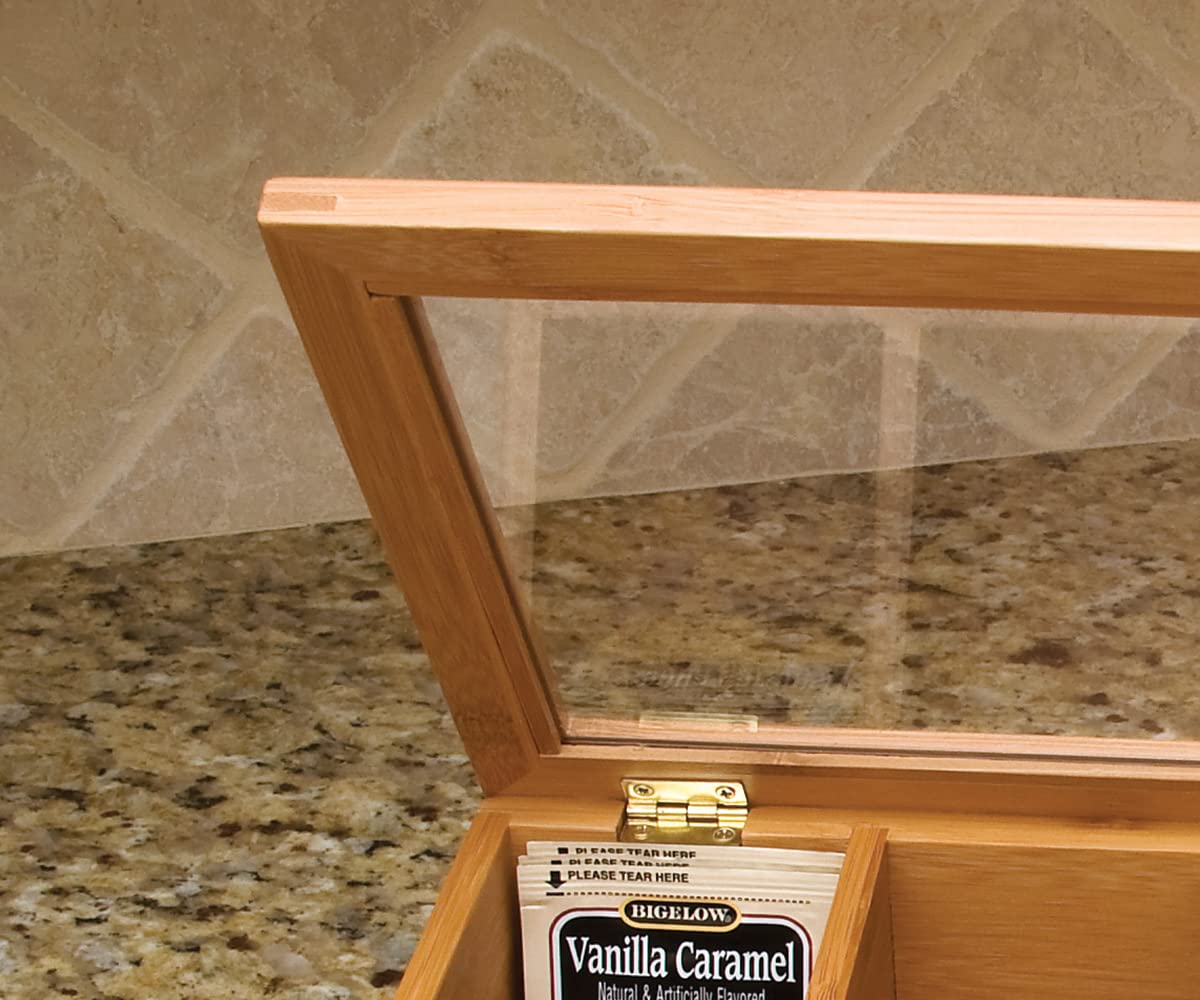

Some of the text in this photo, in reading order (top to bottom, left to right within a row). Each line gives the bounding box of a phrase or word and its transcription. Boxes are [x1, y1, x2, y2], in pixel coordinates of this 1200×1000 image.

[567, 870, 689, 883] PLEASE TEAR HERE
[631, 904, 729, 922] BIGELOW
[565, 934, 797, 984] Vanilla Caramel
